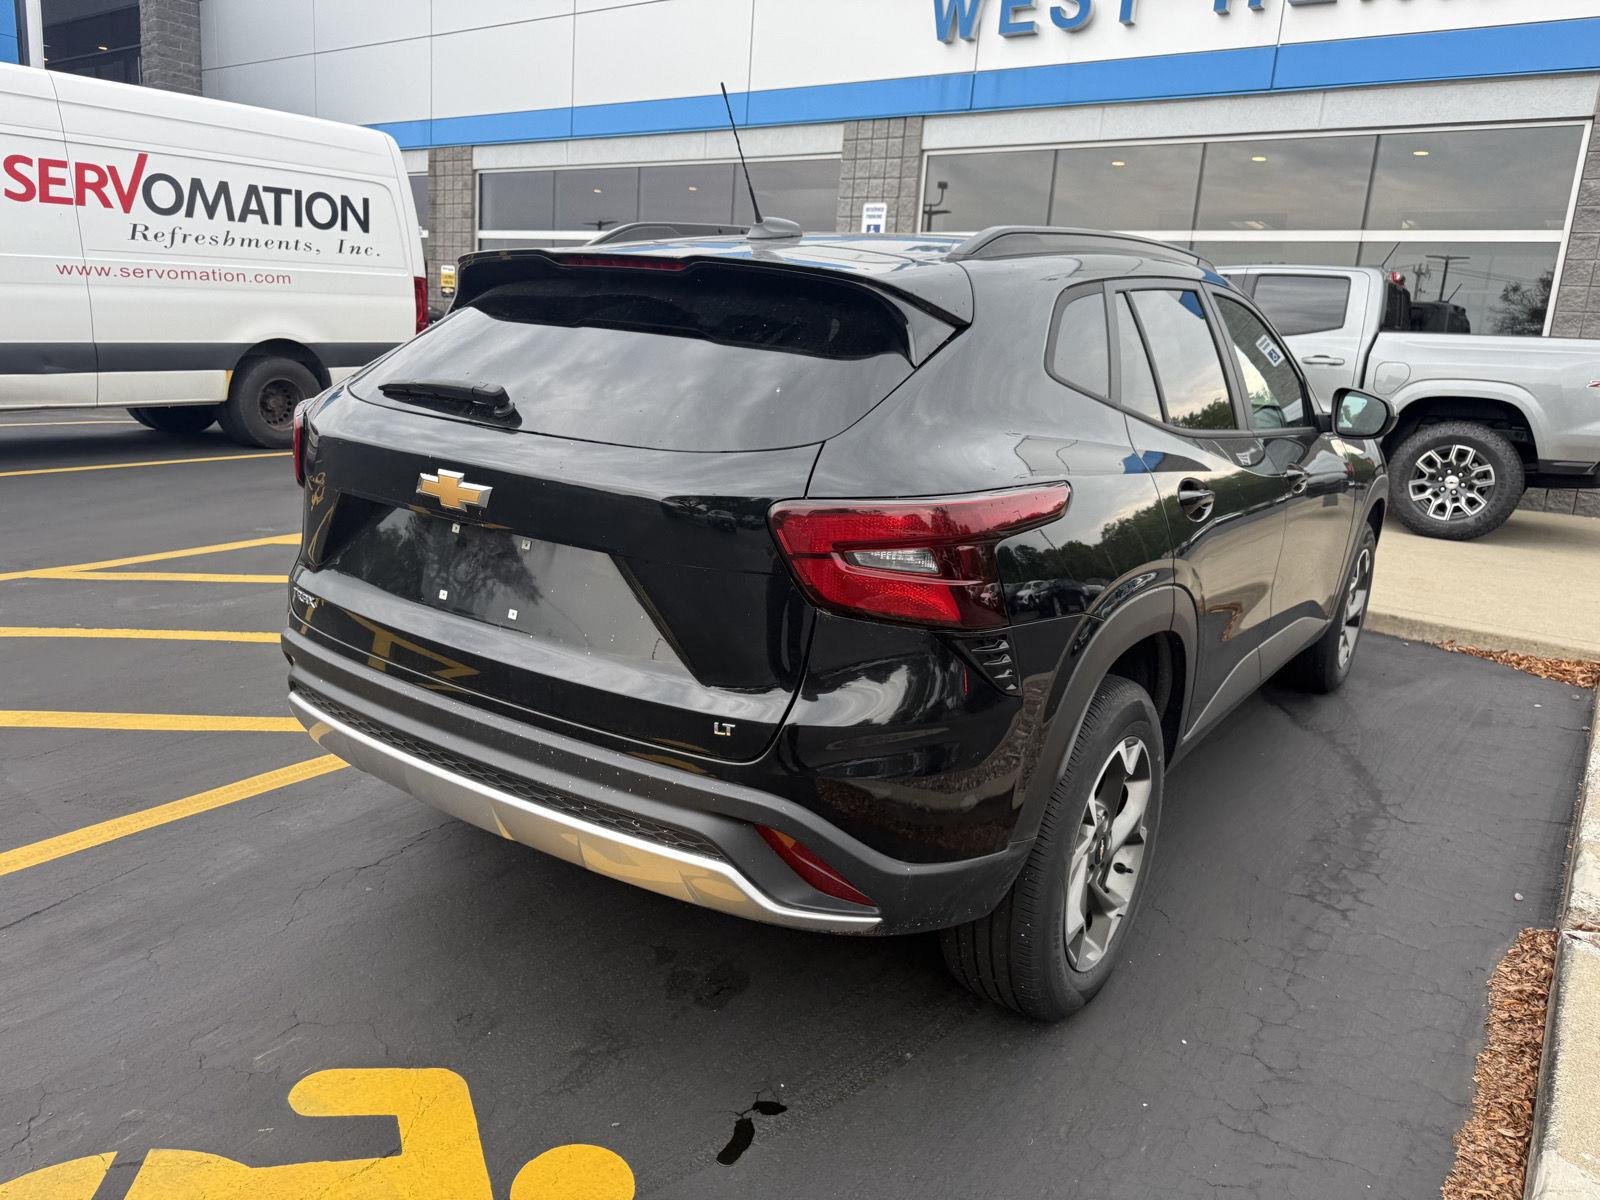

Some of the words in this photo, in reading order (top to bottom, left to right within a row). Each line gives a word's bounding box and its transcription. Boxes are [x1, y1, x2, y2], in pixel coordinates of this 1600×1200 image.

[3, 153, 370, 234] SERVOMATION
[127, 222, 322, 255] Refreshments,
[336, 238, 382, 258] Inc.
[56, 263, 292, 285] www.servomation.com
[713, 721, 736, 737] LT
